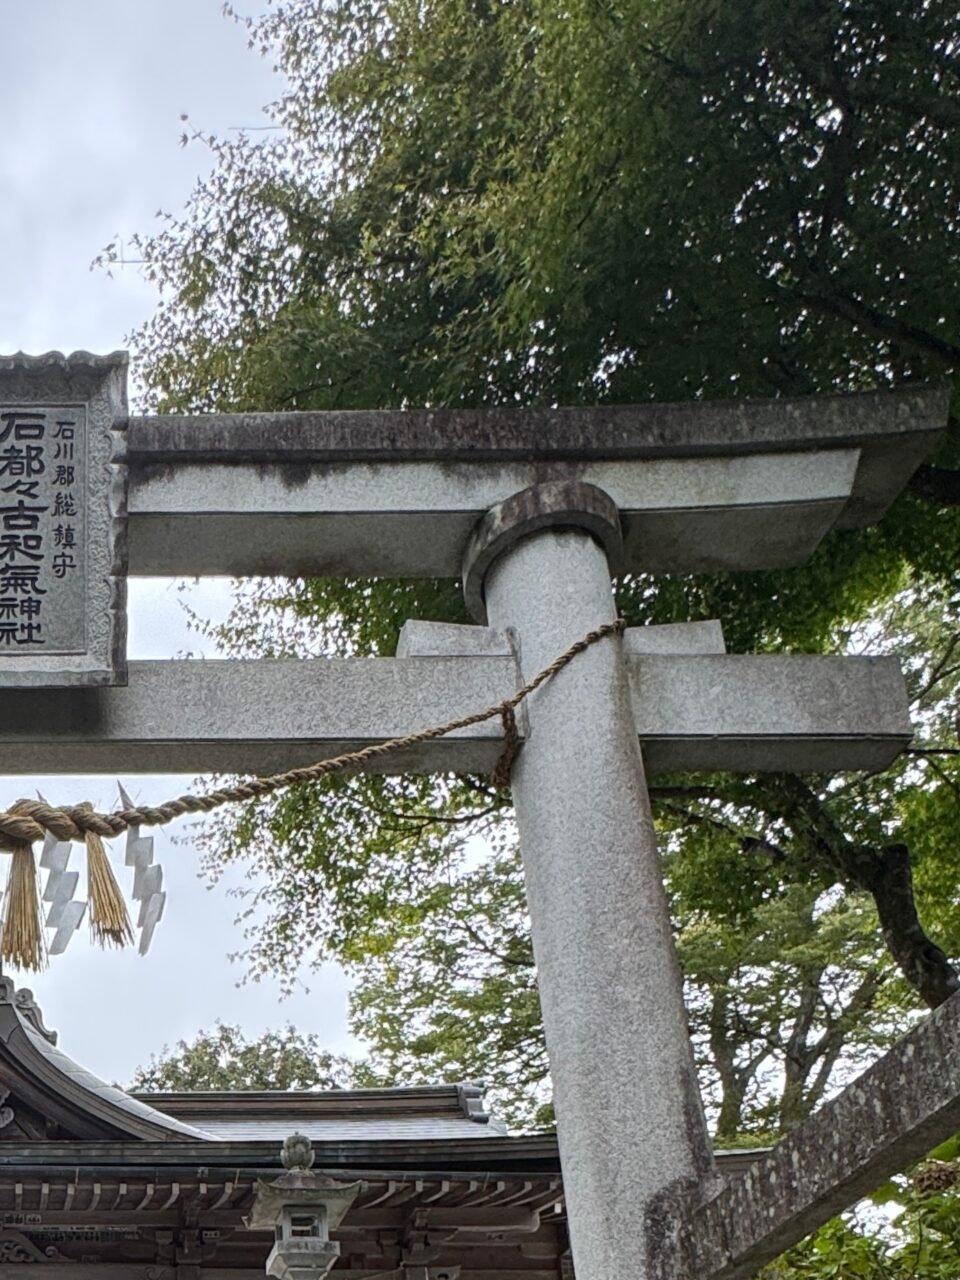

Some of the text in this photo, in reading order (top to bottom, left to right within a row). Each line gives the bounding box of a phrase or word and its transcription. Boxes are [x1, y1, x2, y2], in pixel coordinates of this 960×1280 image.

[51, 421, 78, 579] 石川郡総鎮守
